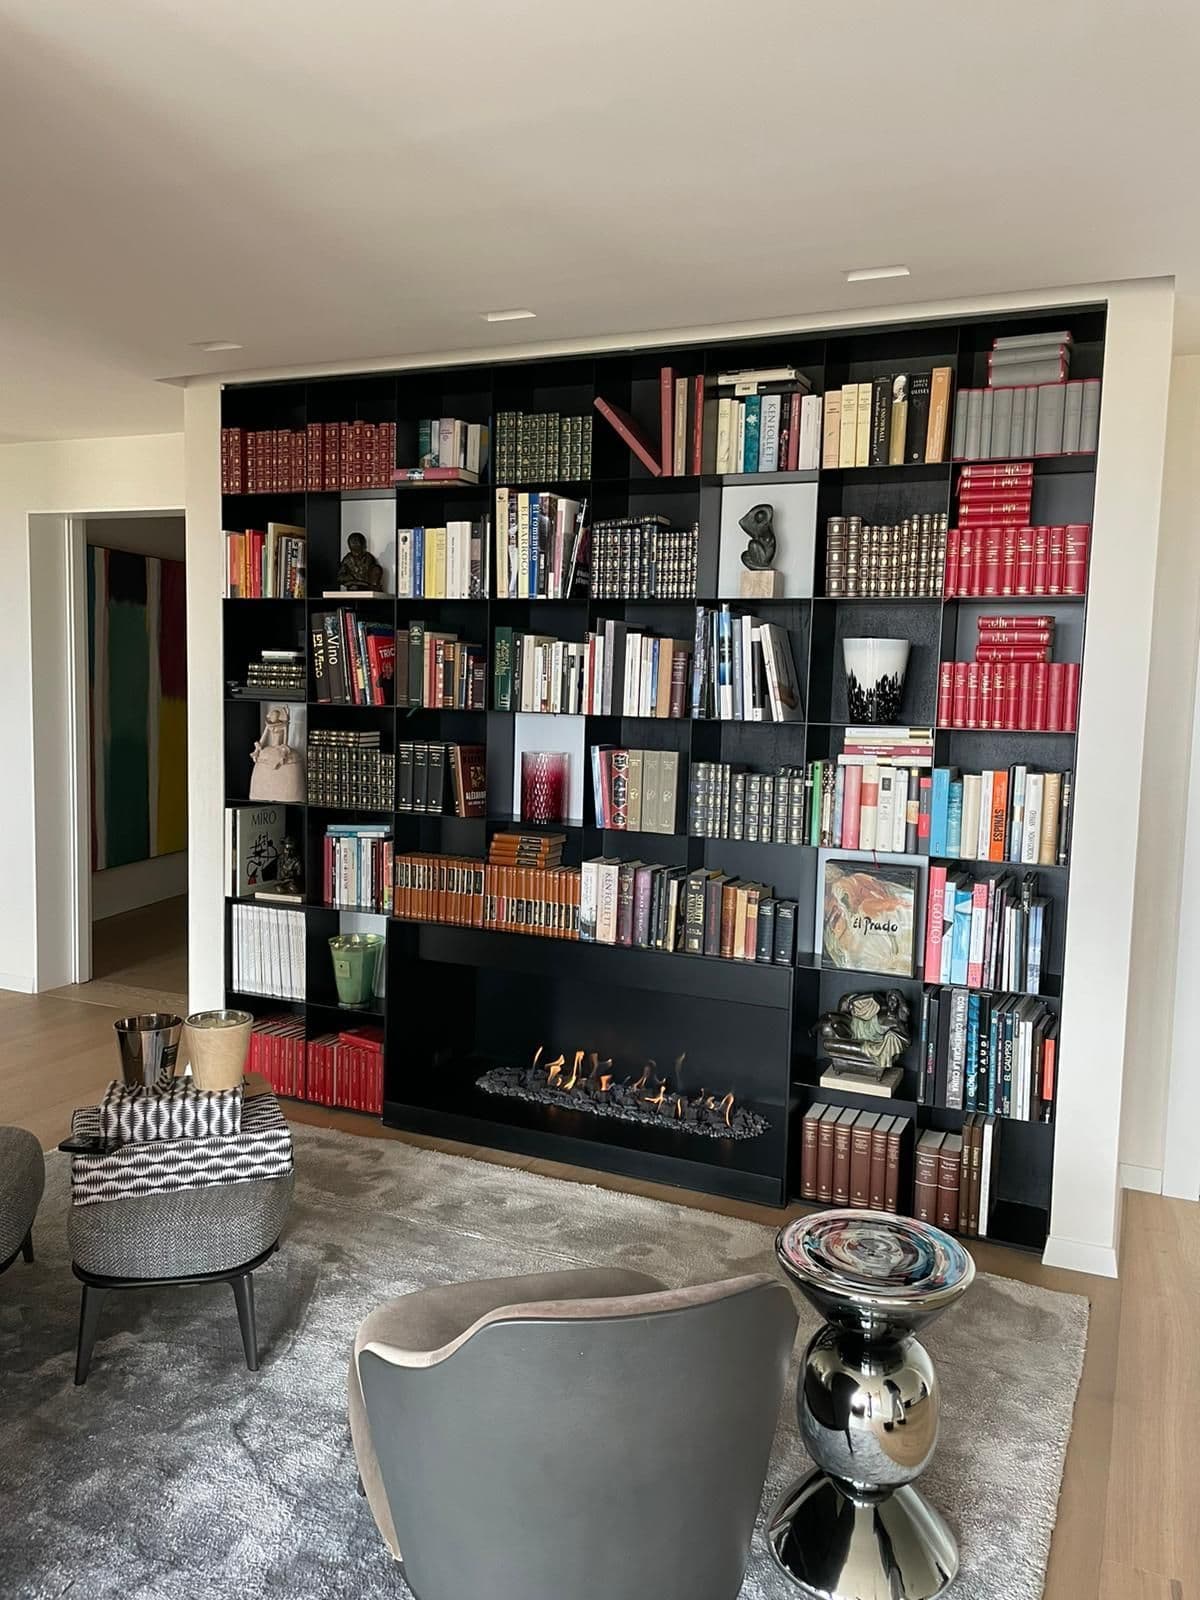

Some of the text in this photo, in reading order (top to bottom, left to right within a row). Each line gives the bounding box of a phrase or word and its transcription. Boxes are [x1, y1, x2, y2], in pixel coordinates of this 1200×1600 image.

[767, 403, 776, 423] KEN
[520, 523, 528, 576] BARROCO
[312, 633, 325, 678] El Vino
[327, 635, 340, 665] Vino
[933, 889, 943, 899] EL
[853, 916, 898, 936] El Prado
